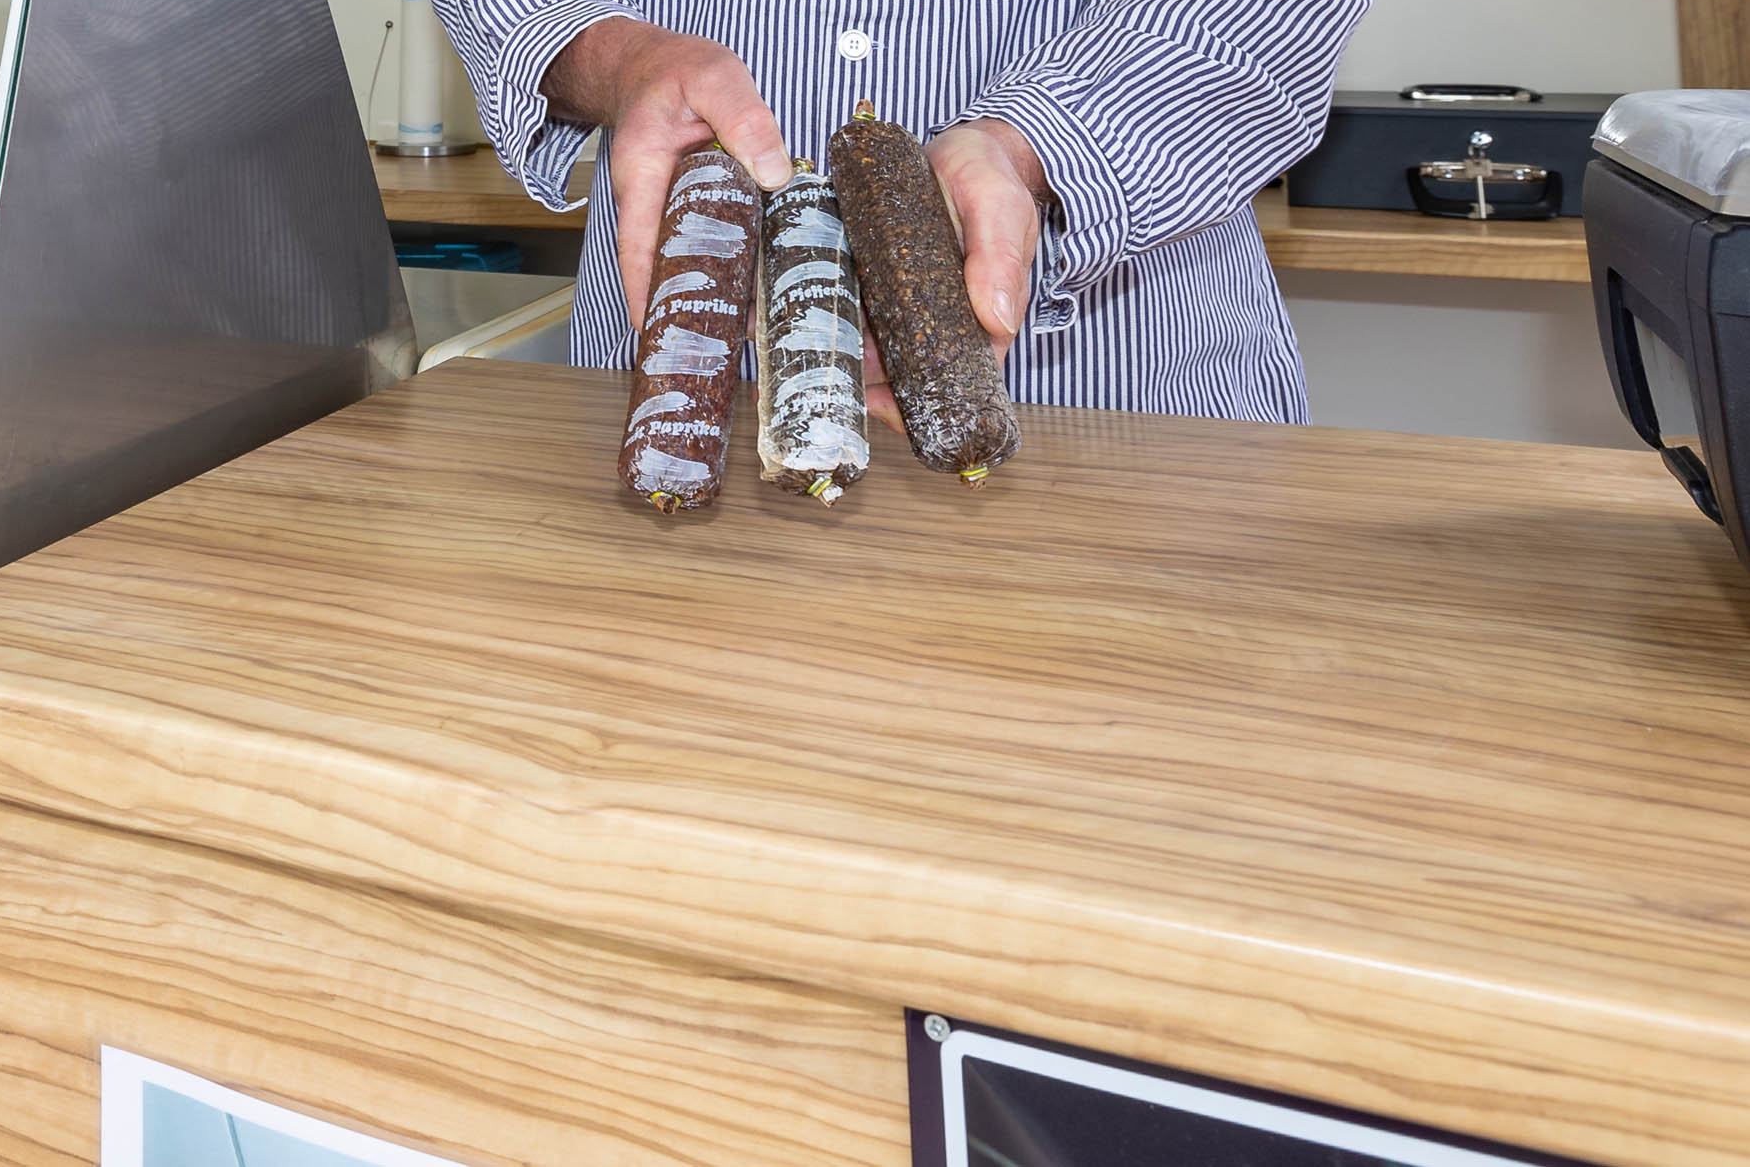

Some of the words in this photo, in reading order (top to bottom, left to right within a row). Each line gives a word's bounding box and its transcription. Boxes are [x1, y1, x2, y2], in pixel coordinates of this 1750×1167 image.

[688, 188, 754, 206] Paprika
[668, 298, 739, 316] Paprika
[648, 420, 721, 437] Paprika
